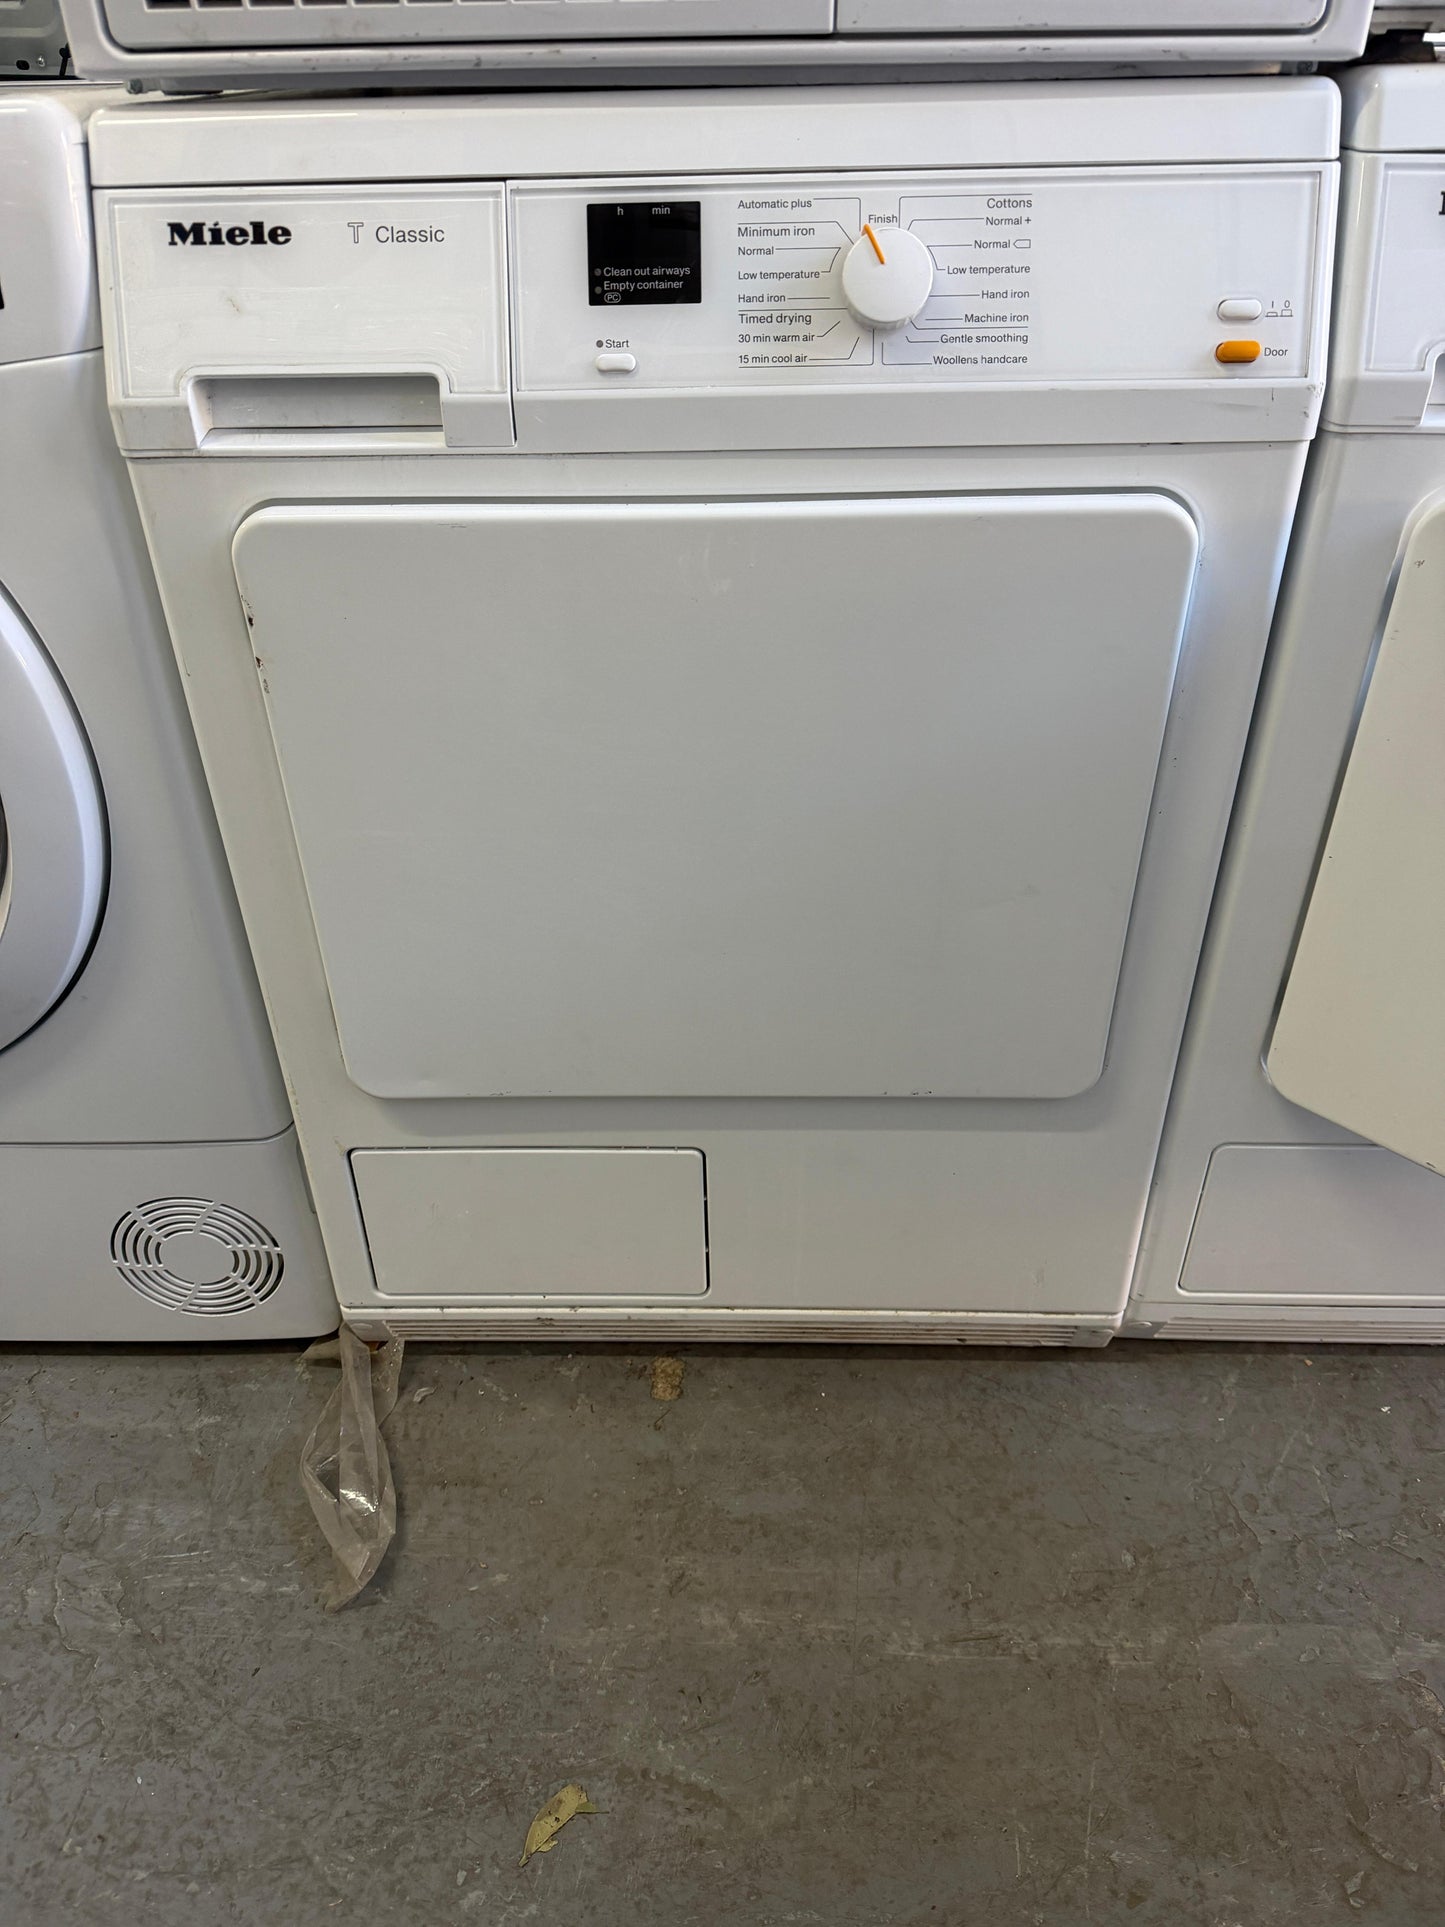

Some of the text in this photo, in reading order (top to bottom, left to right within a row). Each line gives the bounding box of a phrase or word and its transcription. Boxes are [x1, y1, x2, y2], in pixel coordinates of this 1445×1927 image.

[738, 199, 812, 209] Automatic plus
[987, 198, 1032, 209] Cottons
[617, 206, 670, 215] h min
[868, 214, 898, 223] Finish
[986, 217, 1022, 226] Normal
[167, 221, 292, 246] Miele
[348, 222, 445, 244] T Classic
[738, 227, 815, 237] Minimum iron
[974, 240, 1010, 249] Normal
[738, 247, 774, 256] Normal
[604, 266, 690, 276] Clean out airways
[947, 265, 1030, 275] Low temperature
[738, 270, 820, 281] Low temperature
[604, 280, 683, 291] Empty container
[738, 294, 785, 303] Hand iron
[981, 290, 1029, 299] Hand iron
[739, 313, 812, 325] Timed drying
[964, 314, 1029, 322] Machine iron
[738, 334, 750, 343] 30
[753, 334, 770, 342] min
[802, 333, 814, 342] air
[940, 334, 1028, 344] Gentle smoothing
[605, 339, 629, 348] Start
[1264, 348, 1288, 356] Door
[739, 354, 807, 364] 15 min cool air
[933, 355, 1028, 364] Woollens handcare
